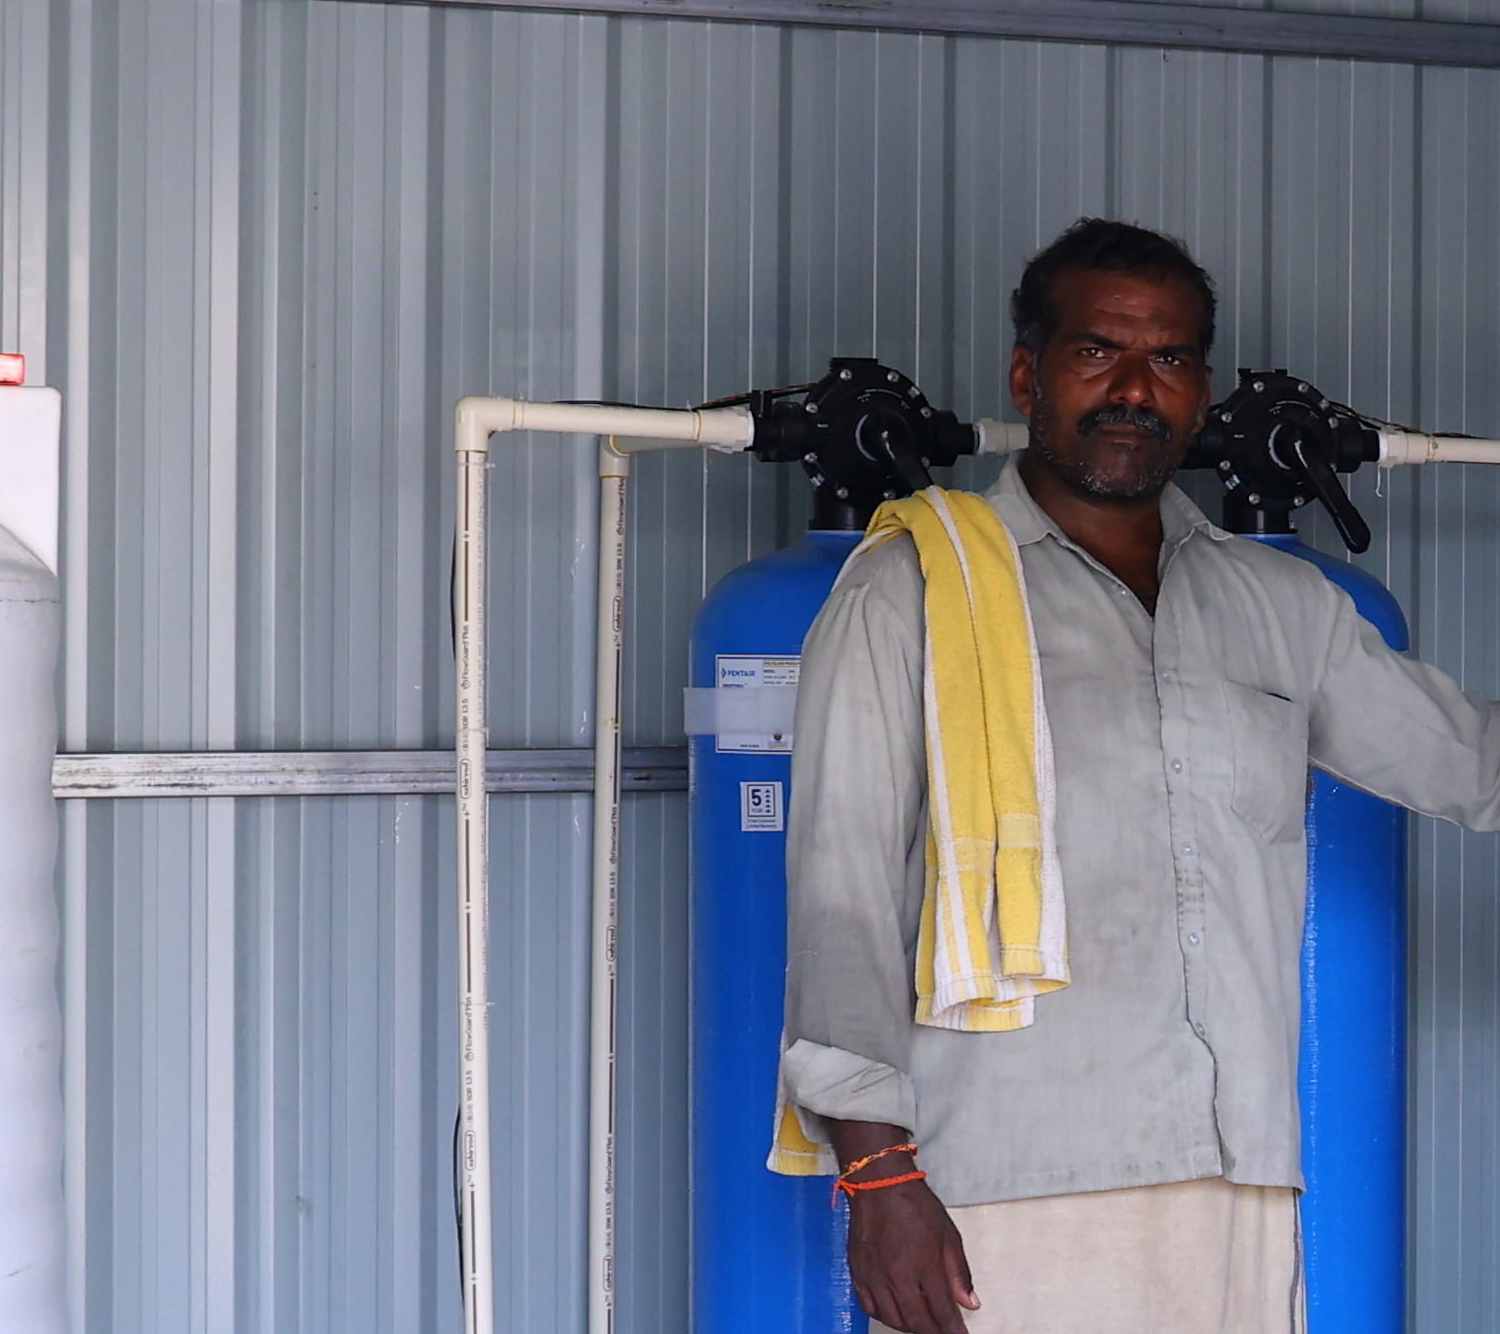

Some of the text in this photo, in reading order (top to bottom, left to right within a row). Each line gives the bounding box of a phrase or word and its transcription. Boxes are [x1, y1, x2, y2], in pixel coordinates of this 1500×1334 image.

[751, 788, 762, 807] 5
[464, 1012, 472, 1051] FlowGuard
[466, 1133, 474, 1167] ashirvad
